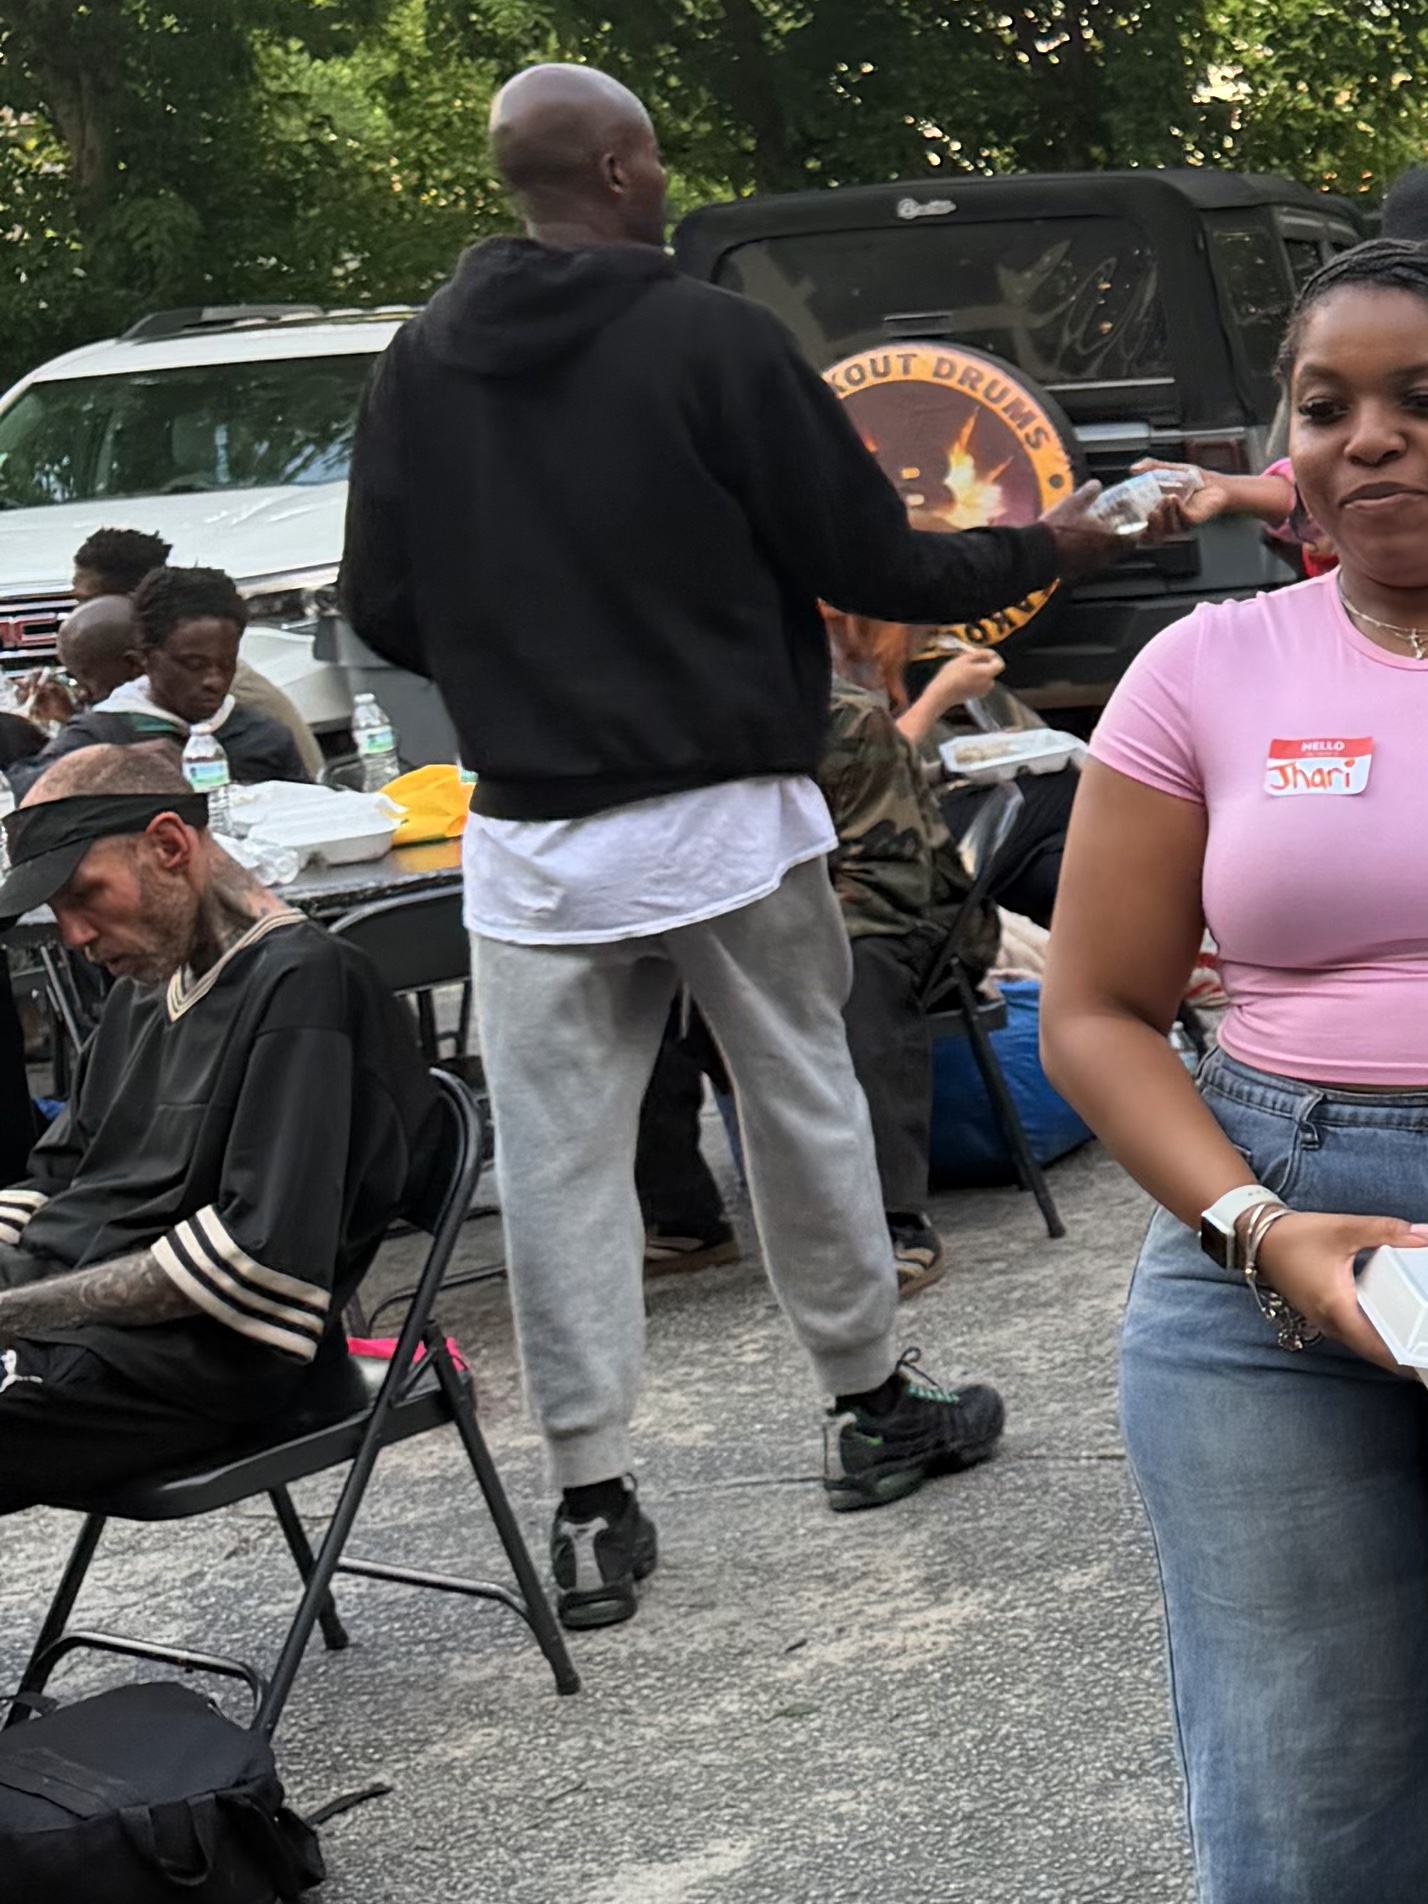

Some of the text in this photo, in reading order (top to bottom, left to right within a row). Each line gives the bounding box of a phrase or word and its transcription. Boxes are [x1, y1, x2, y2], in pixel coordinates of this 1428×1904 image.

[931, 357, 1051, 450] DRUMS
[1301, 740, 1346, 752] HELLO
[1267, 758, 1356, 791] Jhari
